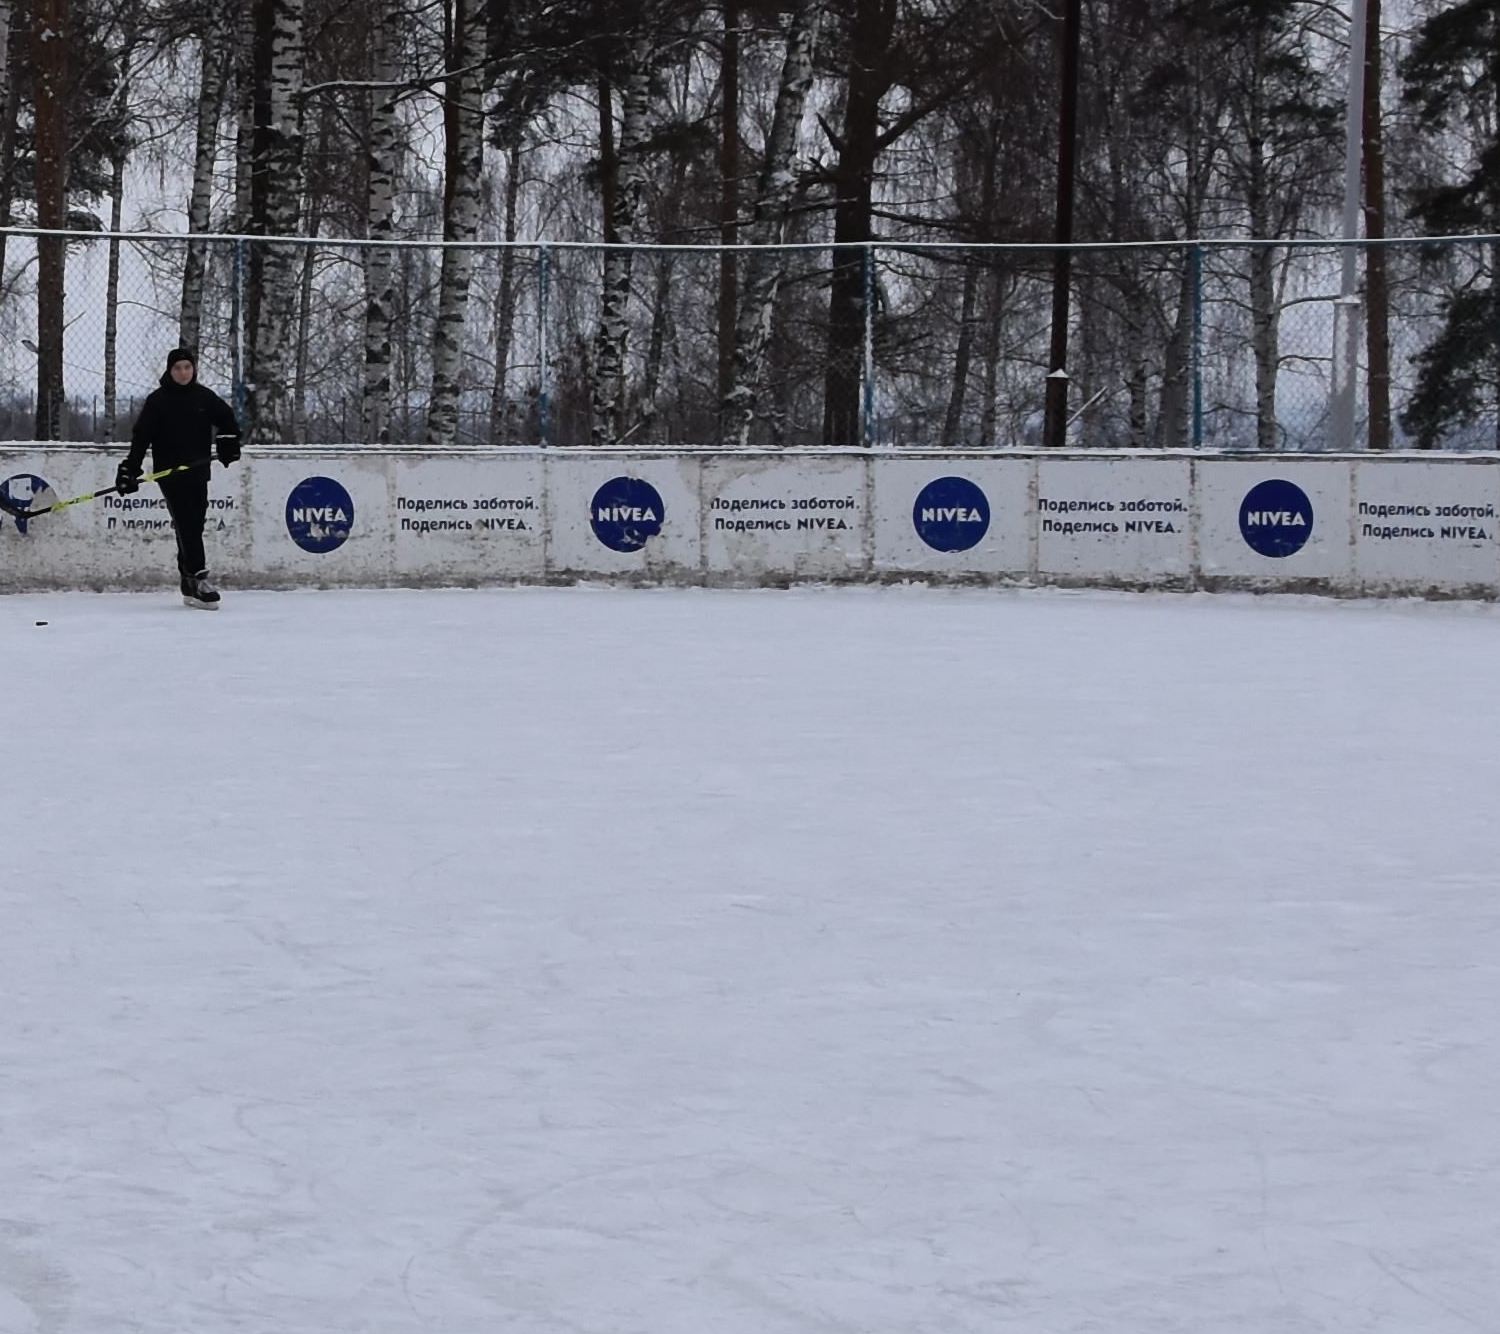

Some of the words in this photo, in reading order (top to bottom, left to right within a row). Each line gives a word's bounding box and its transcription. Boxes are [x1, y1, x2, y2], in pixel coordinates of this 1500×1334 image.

[104, 496, 168, 511] Поделис
[397, 498, 468, 511] Поделись
[472, 496, 539, 511] заботой.
[791, 496, 860, 510] заботой.
[1038, 499, 1114, 514] Поделись
[1119, 498, 1188, 513] заботой.
[1359, 502, 1431, 517] Поделись
[1435, 502, 1500, 519] заботой.
[293, 507, 348, 522] NIVEA
[599, 507, 656, 521] NIVEA
[922, 507, 982, 522] NIVEA
[1248, 511, 1306, 526] NIVEA
[401, 518, 472, 533] Поделись
[715, 518, 791, 533] Поделись
[797, 517, 853, 530] NIVEA.
[1043, 520, 1119, 535] Поделись
[1125, 520, 1181, 533] NIVEA.
[1363, 524, 1434, 539] Поделись
[1440, 526, 1493, 539] NIVEA.
